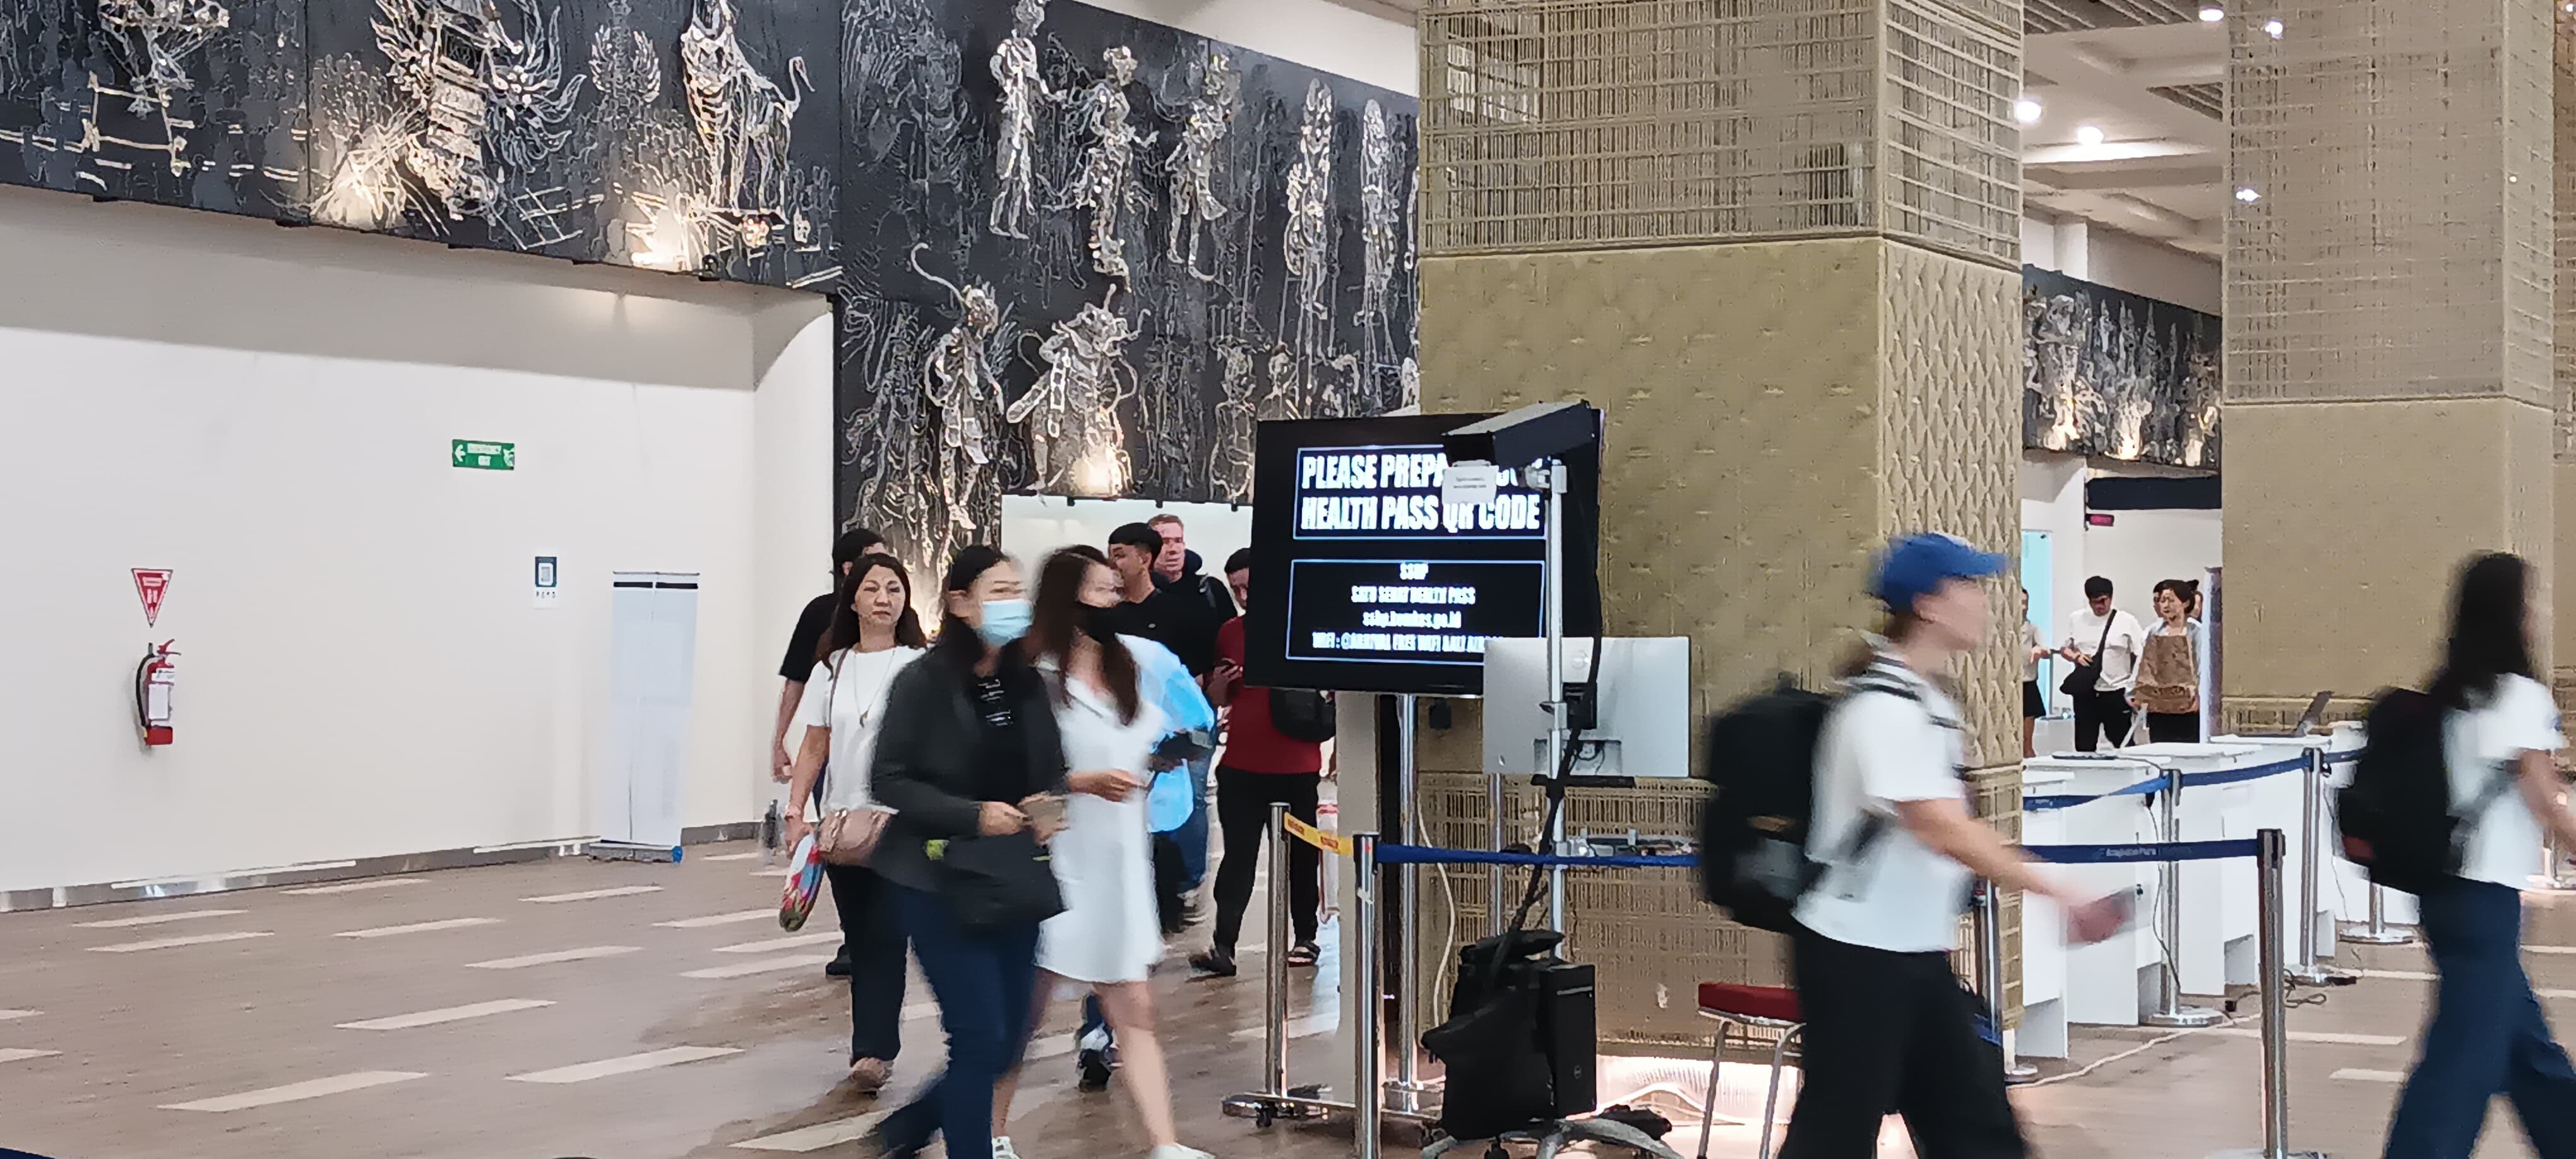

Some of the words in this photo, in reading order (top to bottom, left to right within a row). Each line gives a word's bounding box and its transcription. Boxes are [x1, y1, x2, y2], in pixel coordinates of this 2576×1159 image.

[1301, 455, 1378, 489] PLEASE
[1380, 453, 1449, 488] PREPA
[1301, 496, 1378, 530] HEALTH
[1381, 495, 1439, 530] PASS
[1478, 494, 1541, 530] CODE
